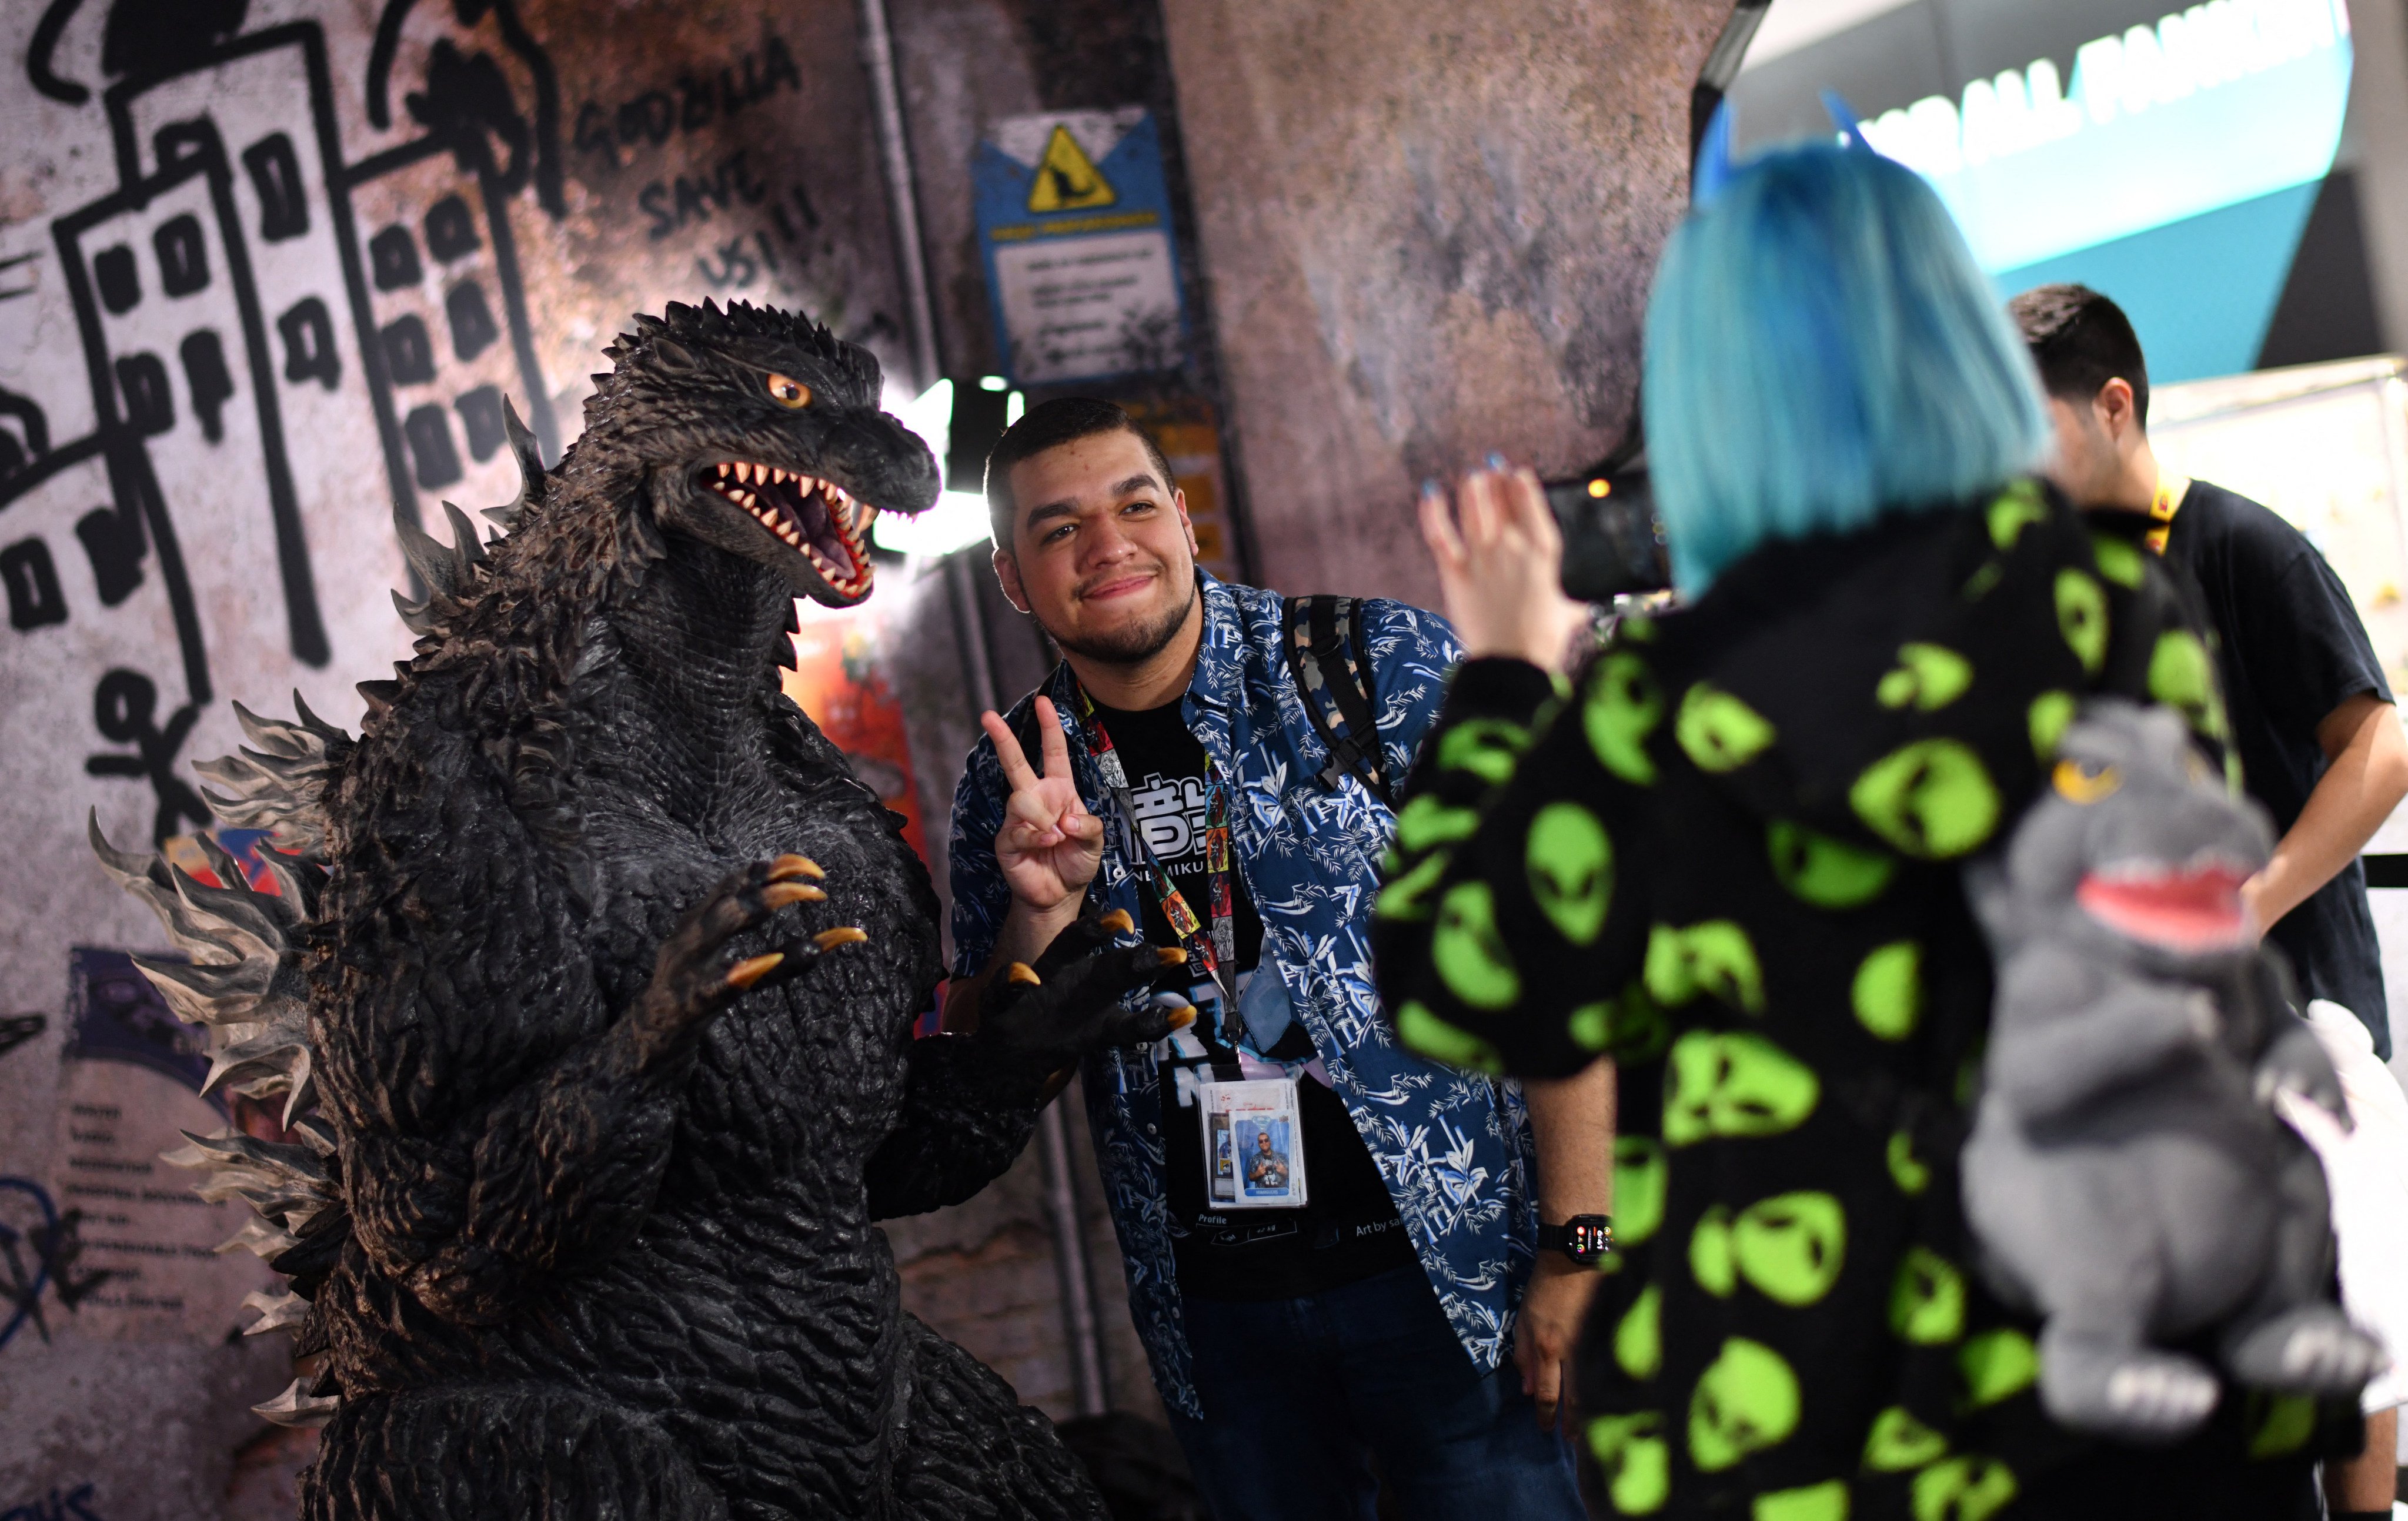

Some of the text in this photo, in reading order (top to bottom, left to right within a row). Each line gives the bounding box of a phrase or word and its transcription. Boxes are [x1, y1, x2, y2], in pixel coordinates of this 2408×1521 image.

[1167, 861, 1204, 877] MIKU
[1198, 1214, 1227, 1225] Profile
[1356, 1224, 1372, 1237] Art
[1373, 1221, 1387, 1232] by
